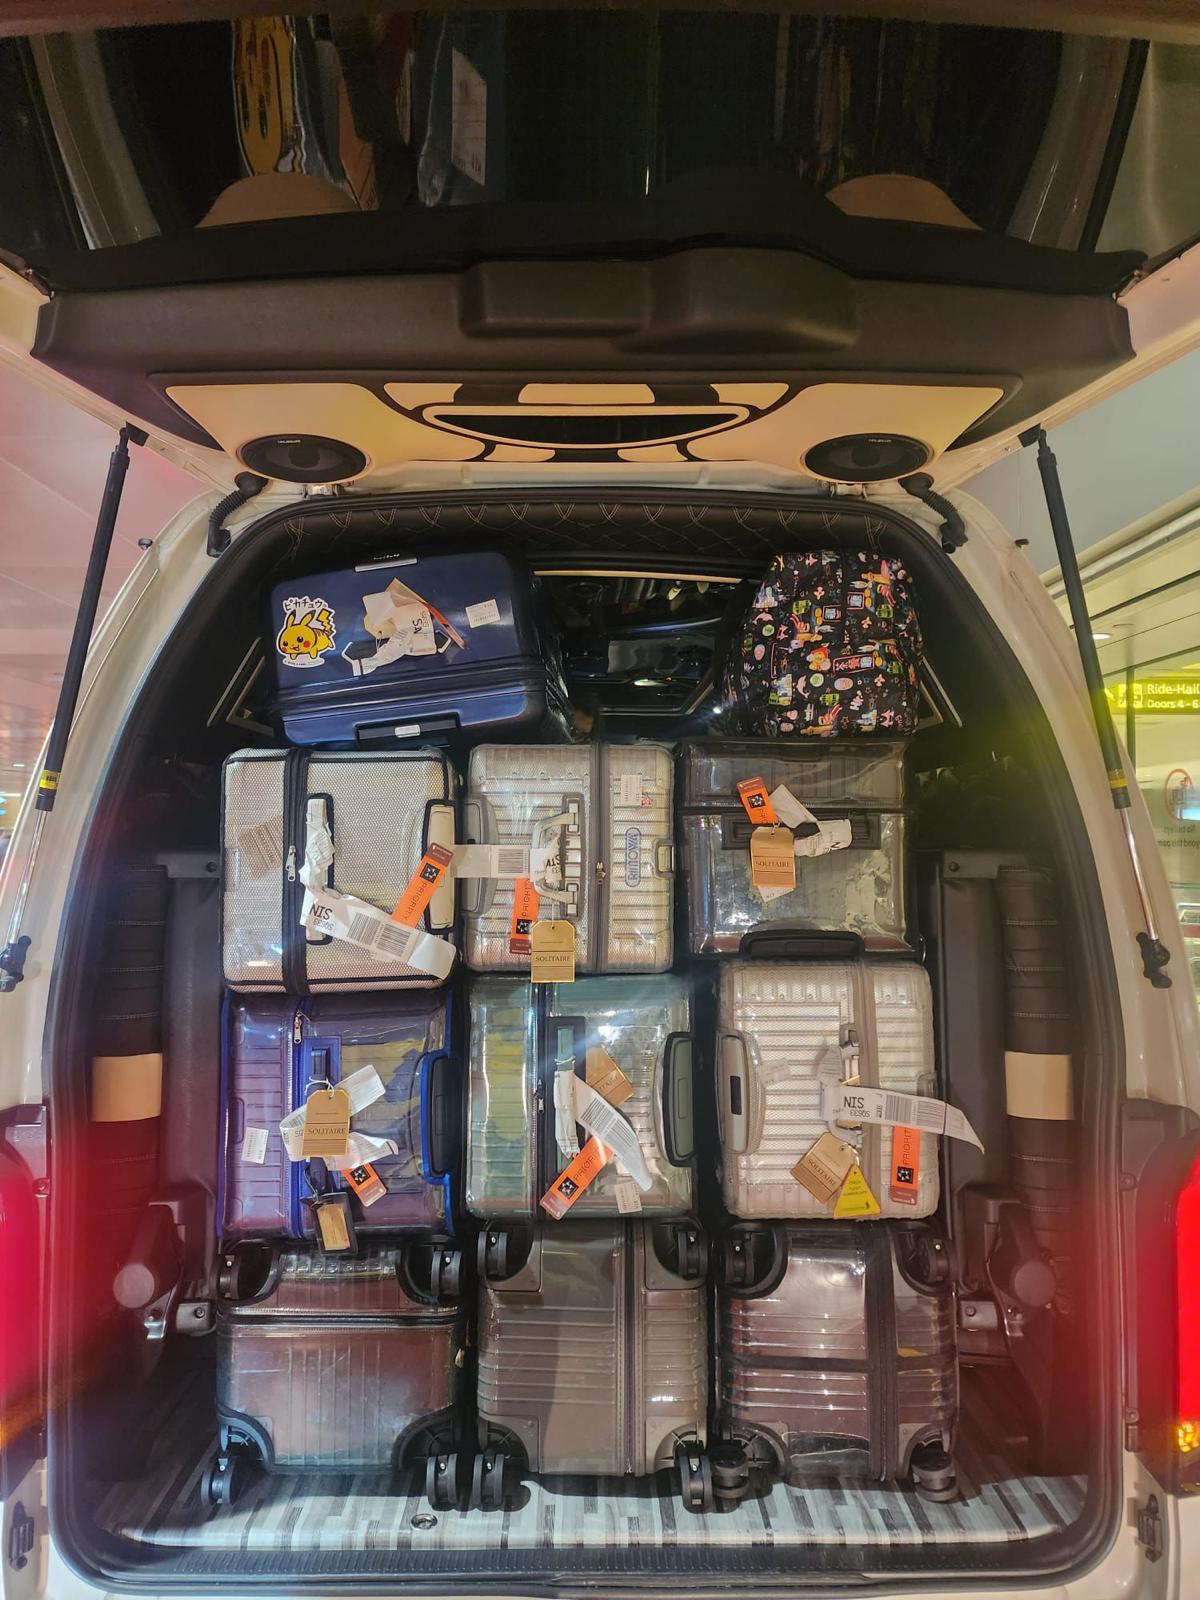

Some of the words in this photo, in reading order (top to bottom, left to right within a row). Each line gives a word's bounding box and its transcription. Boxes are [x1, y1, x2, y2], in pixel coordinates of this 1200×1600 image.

[284, 598, 323, 611] ピカチュウ
[1147, 699, 1176, 709] Doors
[755, 860, 790, 868] SOLITAIRE
[310, 903, 333, 920] SIN
[843, 1096, 865, 1109] SIN
[308, 1127, 346, 1135] SOLITAIRE
[807, 1158, 837, 1187] SOLITAIRE
